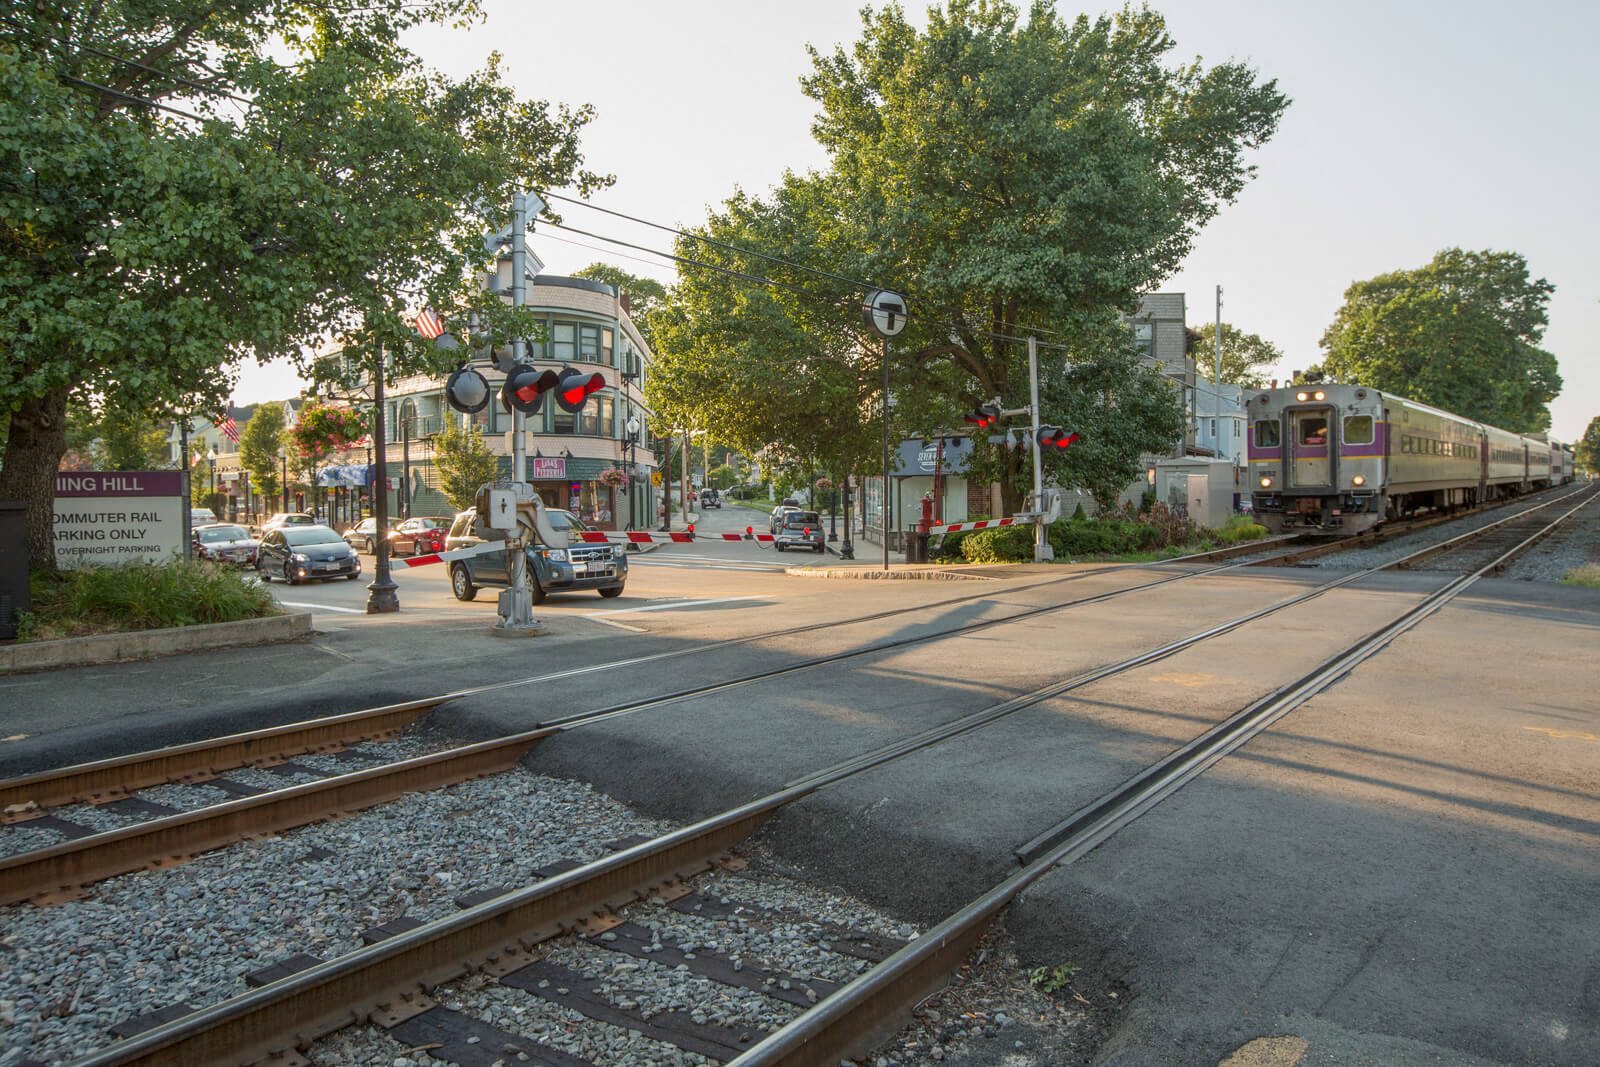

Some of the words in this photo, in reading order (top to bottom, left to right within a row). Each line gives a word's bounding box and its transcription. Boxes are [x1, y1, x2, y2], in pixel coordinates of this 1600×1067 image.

[879, 302, 903, 331] T
[57, 477, 97, 491] ING
[102, 477, 145, 491] HILL
[52, 512, 127, 524] OMMUTER
[130, 511, 163, 523] RAIL
[51, 529, 105, 541] ARKING
[109, 528, 147, 540] ONLY
[57, 545, 116, 556] OVERNIGHT
[118, 544, 161, 554] PARKING
